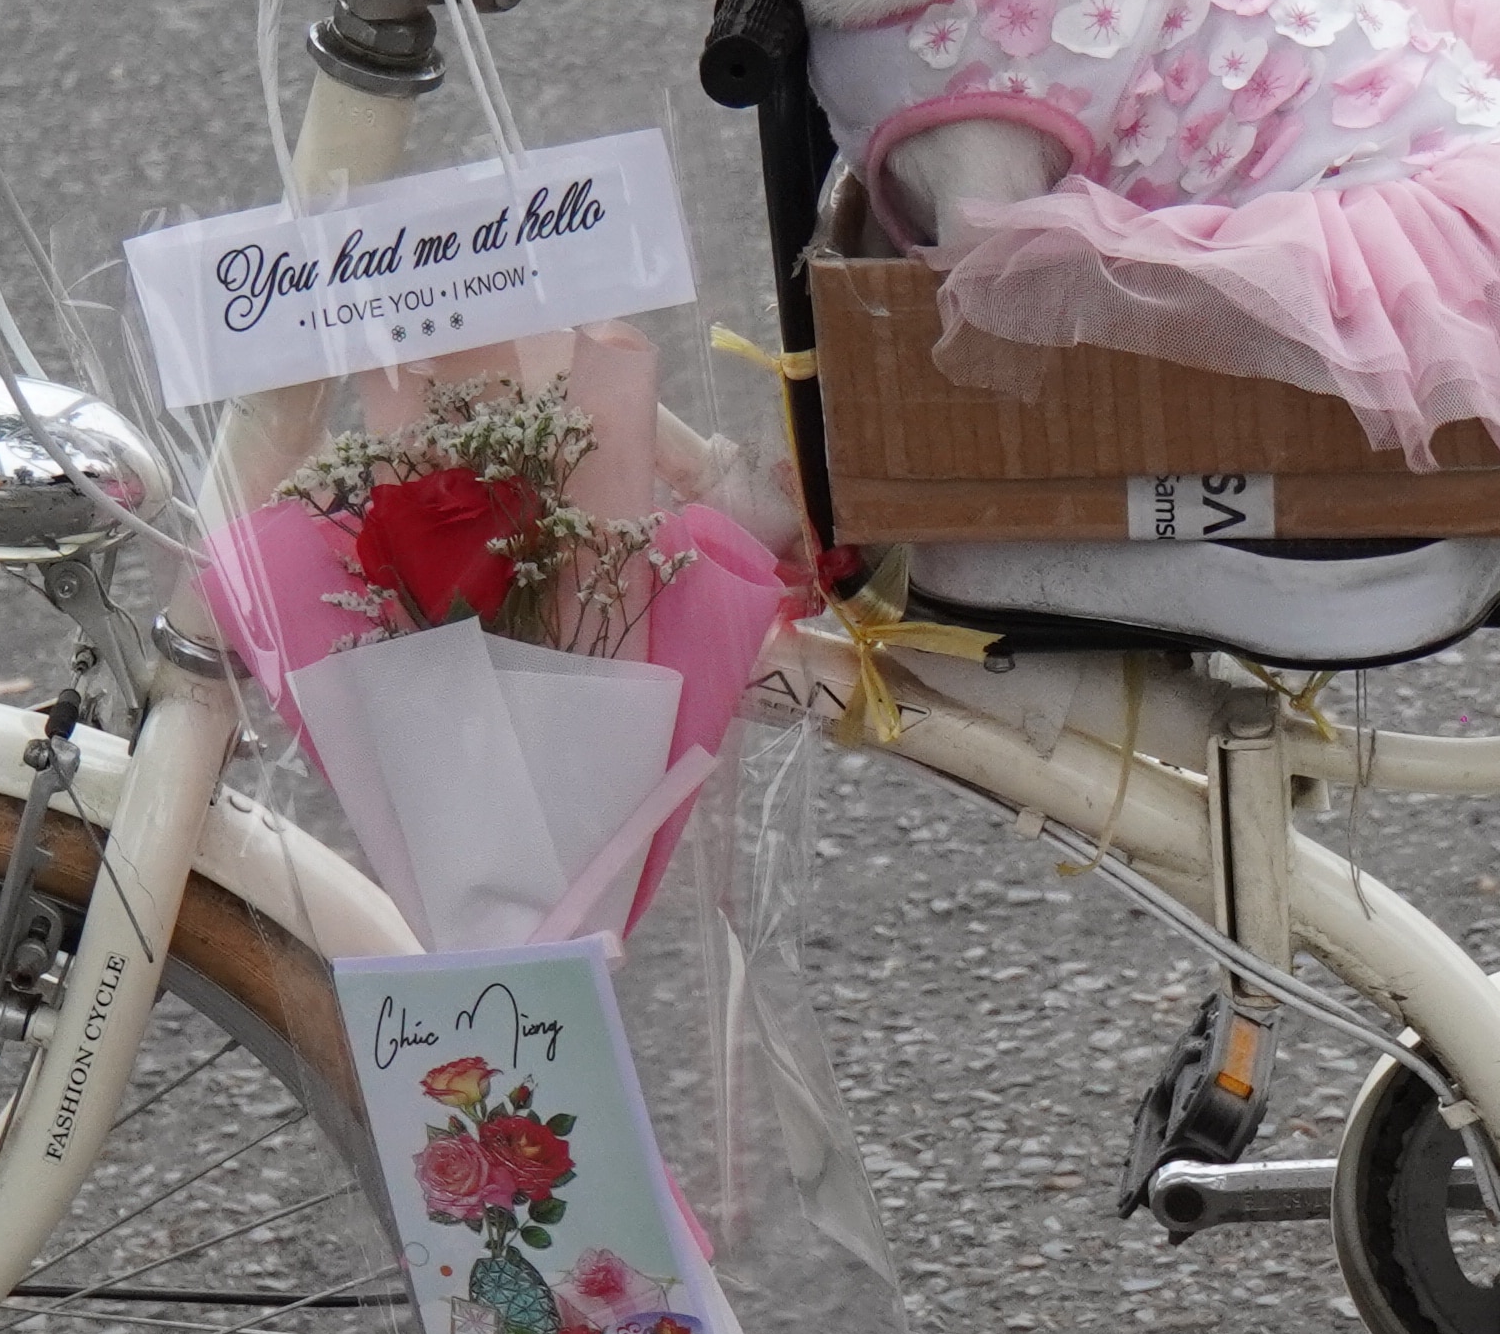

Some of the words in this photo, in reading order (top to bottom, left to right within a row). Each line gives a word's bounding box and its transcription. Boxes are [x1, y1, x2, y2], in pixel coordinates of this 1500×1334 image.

[216, 243, 318, 333] You
[327, 226, 405, 287] had
[412, 229, 461, 271] me
[472, 205, 509, 251] at
[514, 177, 605, 247] hello
[323, 298, 385, 328] LOVE
[388, 287, 436, 317] YOU
[463, 265, 527, 300] KNOW
[46, 1045, 95, 1162] FASHION
[84, 954, 127, 1042] CYCLE
